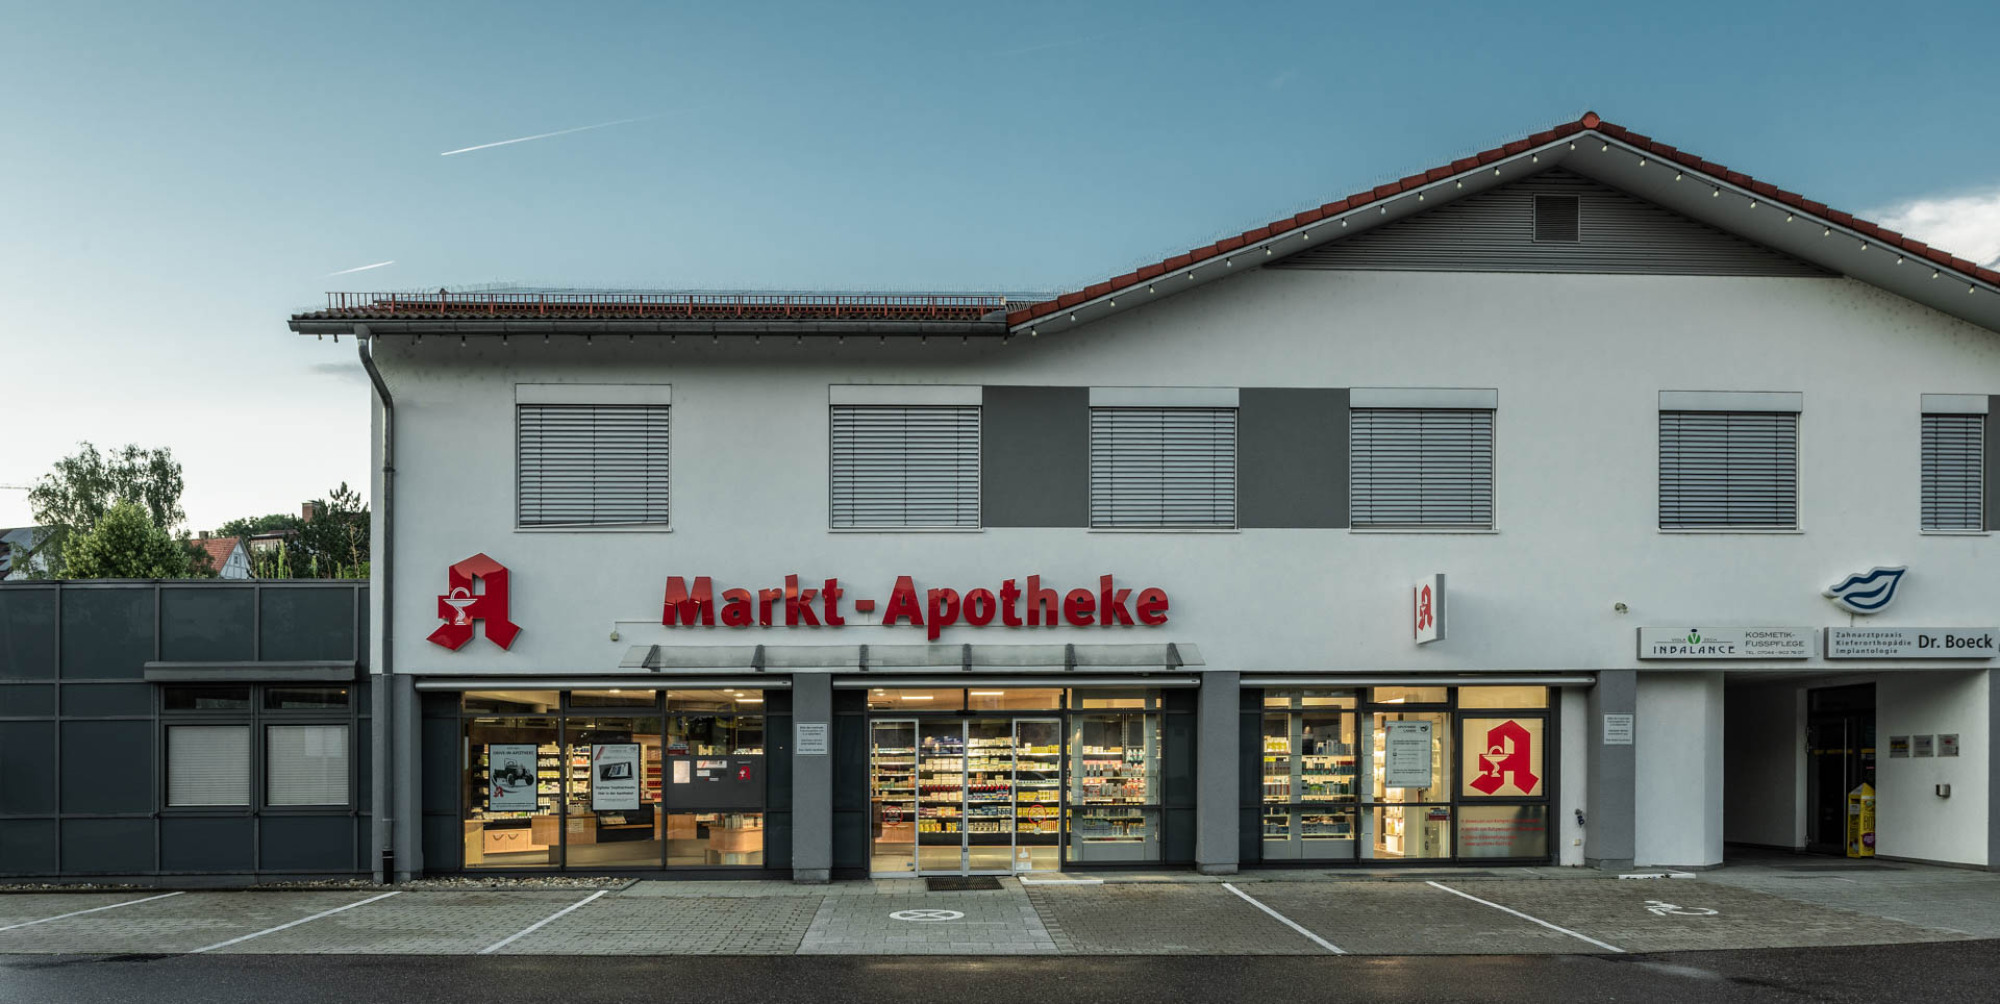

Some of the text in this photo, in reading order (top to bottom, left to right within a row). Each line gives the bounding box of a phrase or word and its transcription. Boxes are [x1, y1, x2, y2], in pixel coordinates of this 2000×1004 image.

[1835, 631, 1902, 639] Zahnarztpraxis
[1918, 633, 1993, 648] Dr. Boeck
[1653, 645, 1736, 655] INBALANCE
